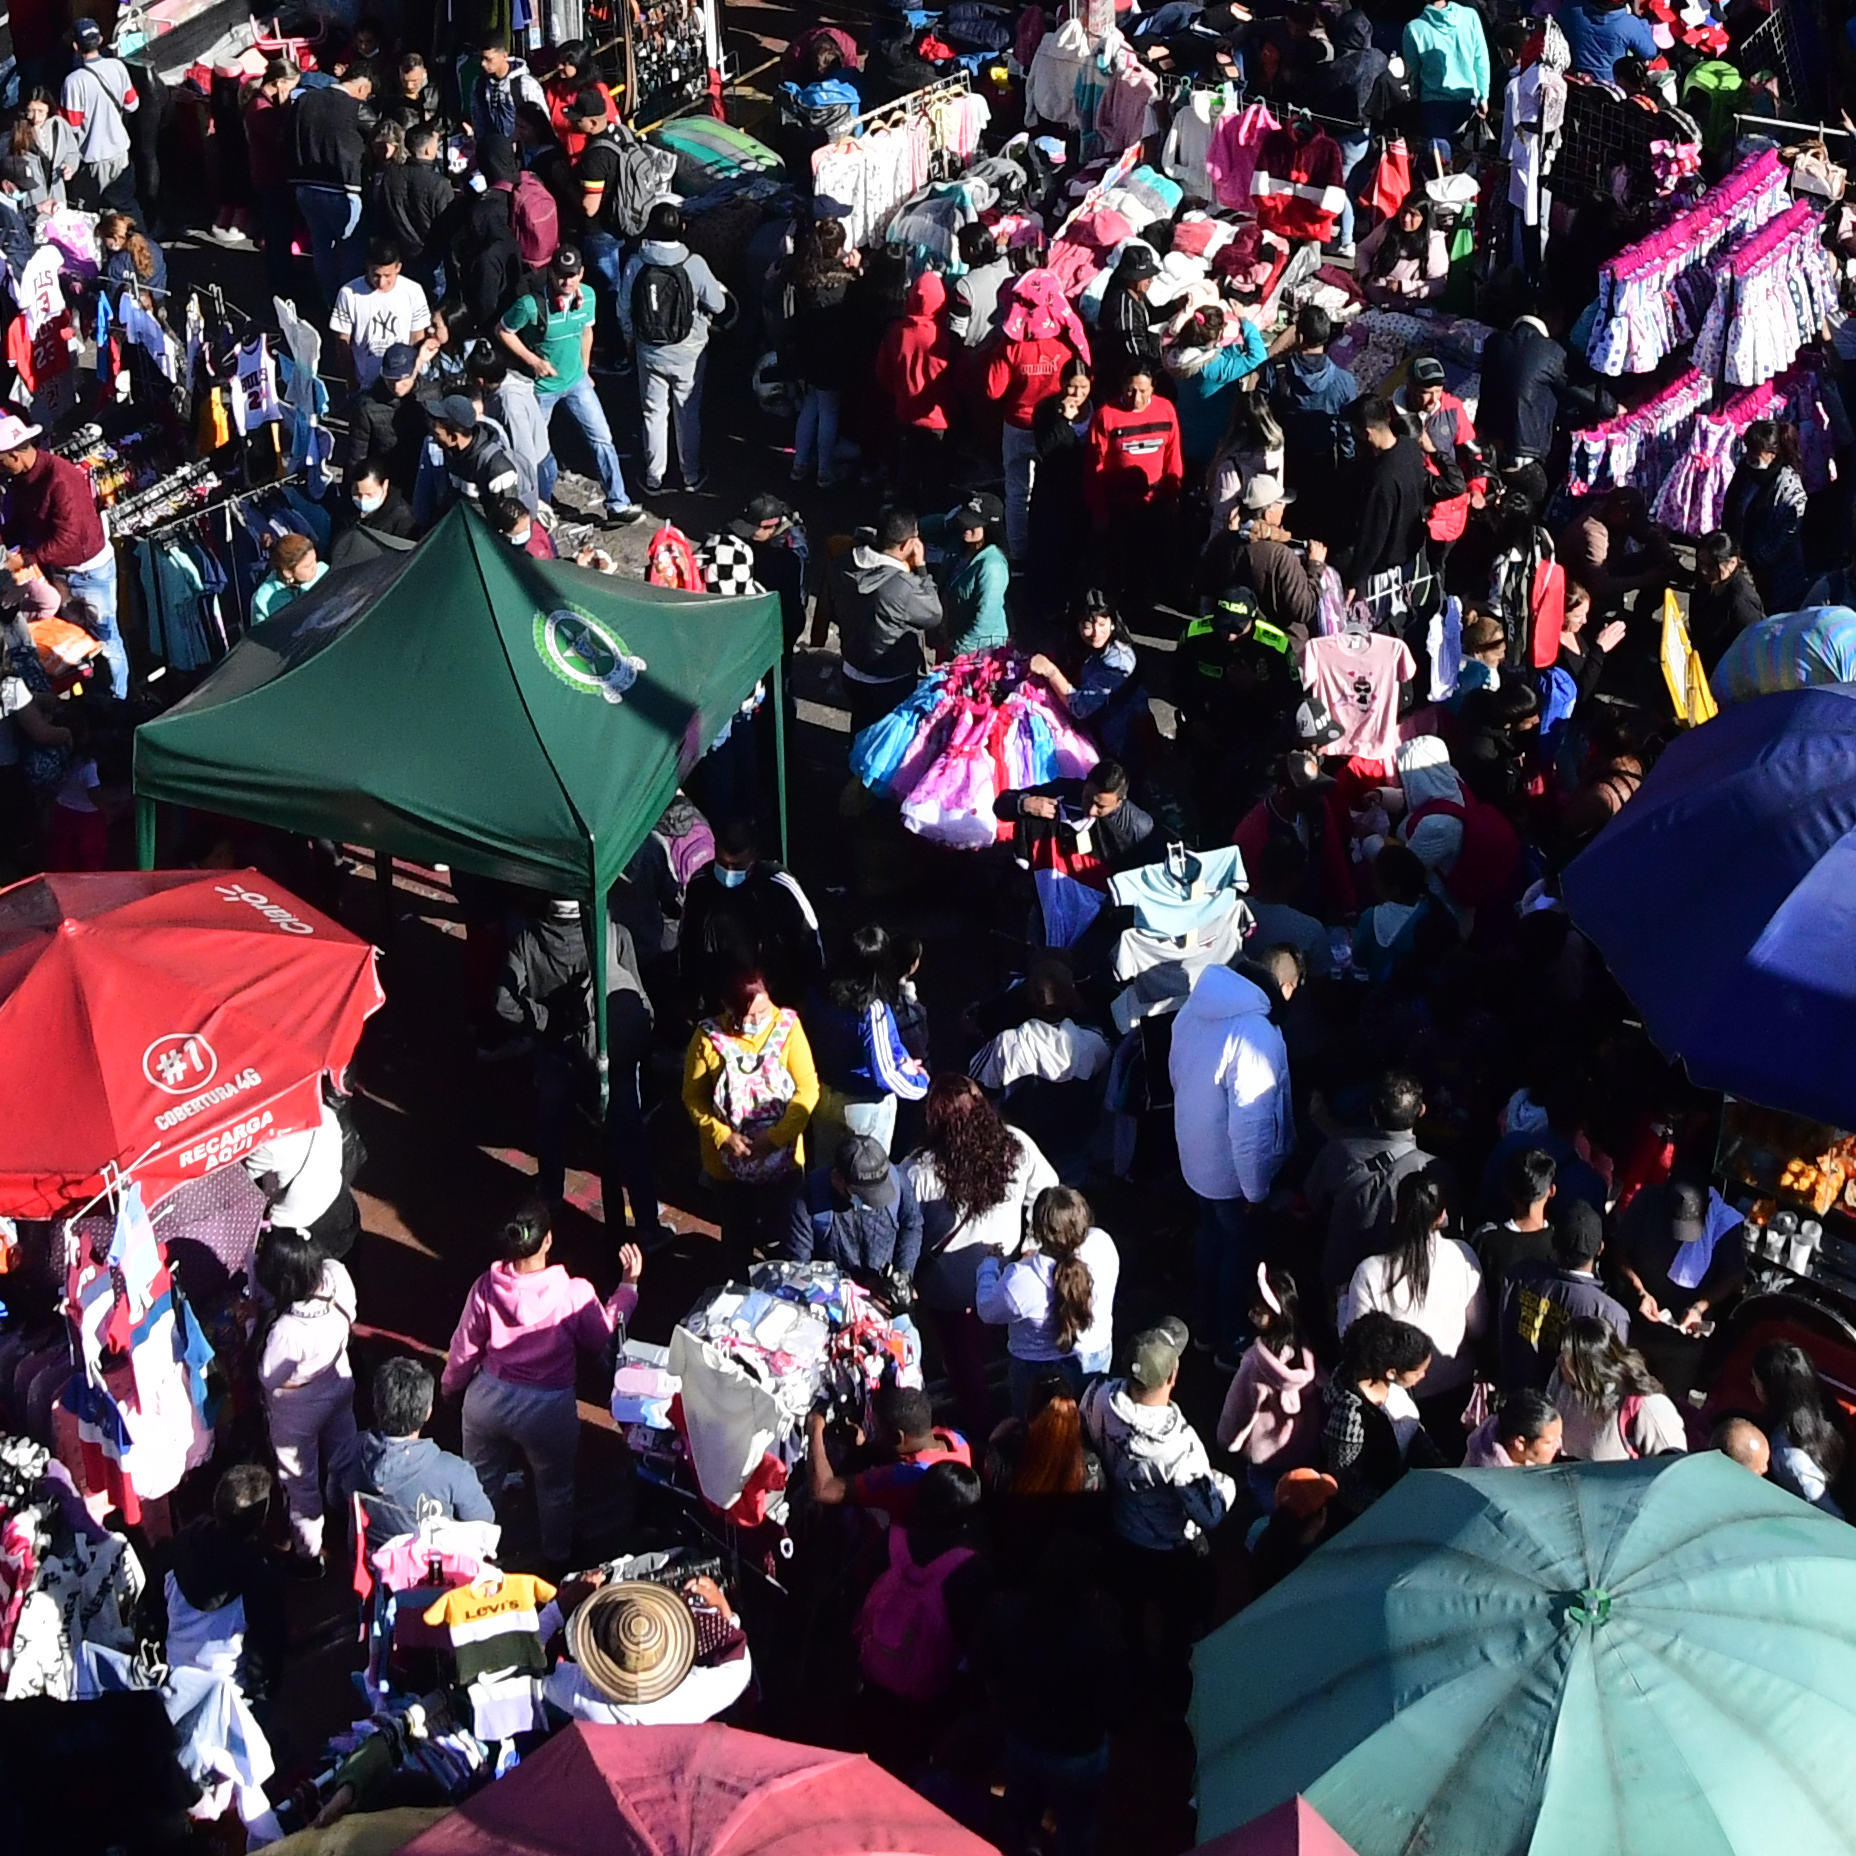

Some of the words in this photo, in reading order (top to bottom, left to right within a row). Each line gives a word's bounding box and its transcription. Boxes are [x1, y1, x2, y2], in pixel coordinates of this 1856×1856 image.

[240, 890, 314, 936] Claro
[156, 1038, 206, 1085] #1
[154, 1078, 242, 1132] COBERTURA
[236, 1067, 263, 1098] 4G
[179, 1109, 274, 1169] RECARGA
